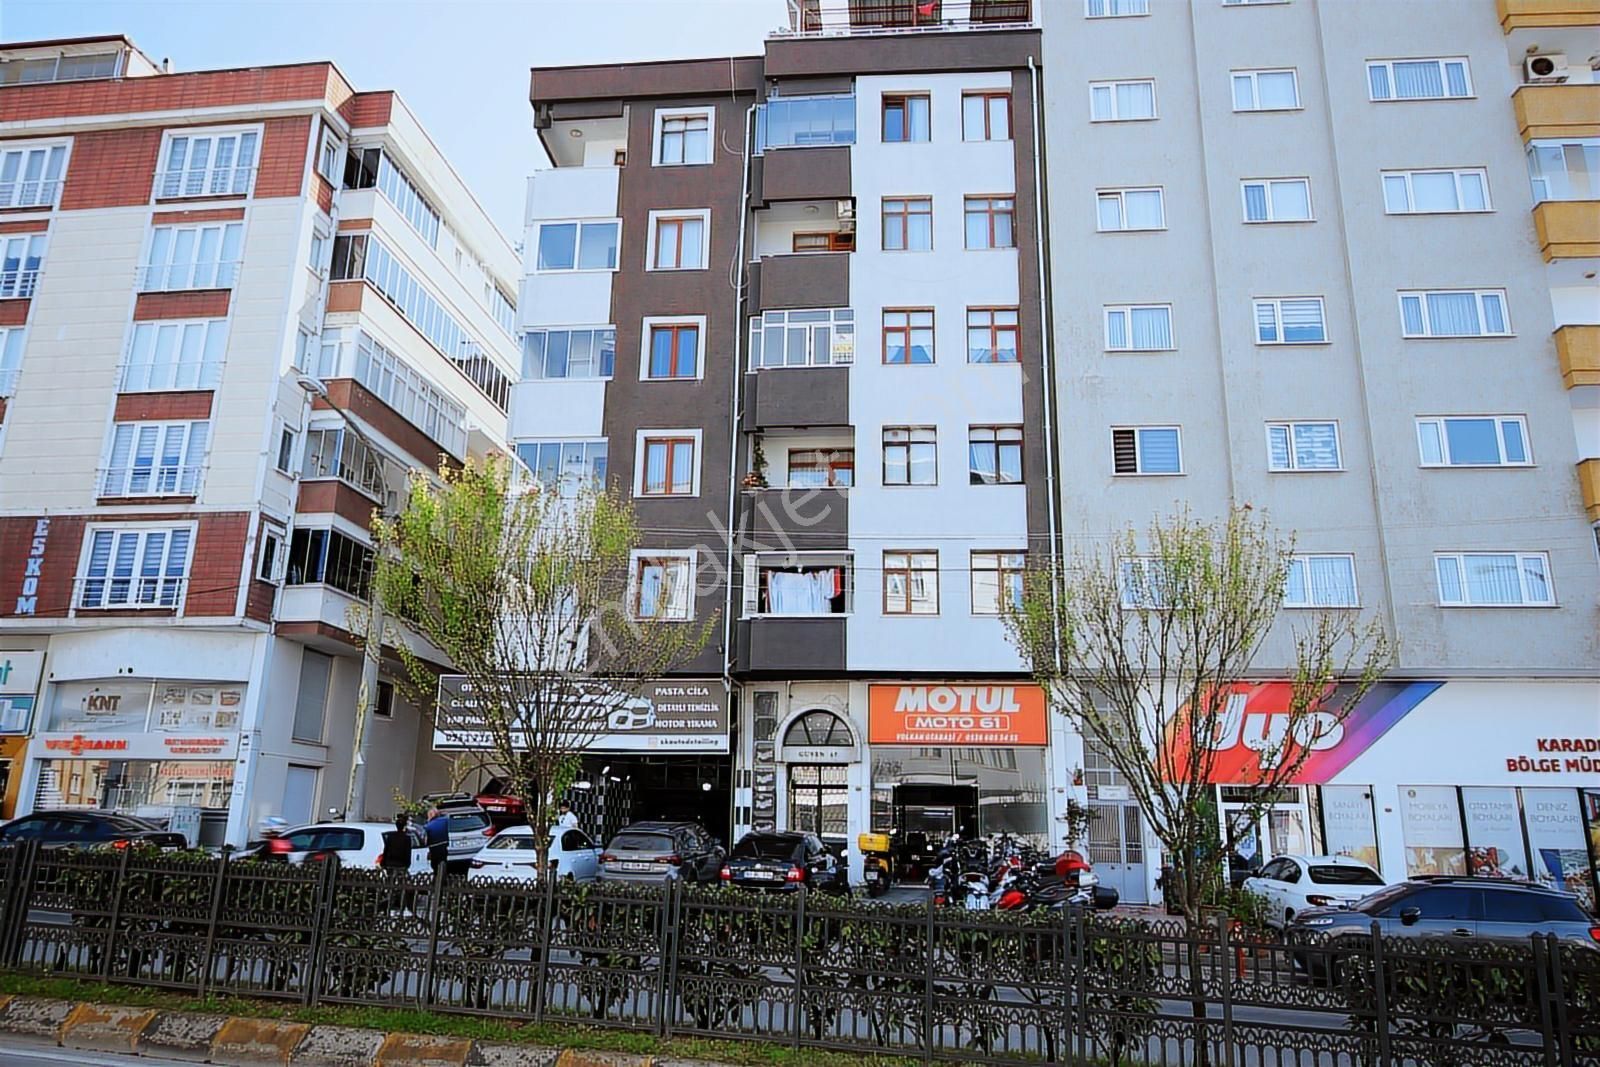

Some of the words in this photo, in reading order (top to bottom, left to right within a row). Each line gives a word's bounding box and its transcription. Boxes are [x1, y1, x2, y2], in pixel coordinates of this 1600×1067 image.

[14, 519, 51, 615] ESKOM
[655, 687, 685, 696] PASTA
[687, 686, 709, 696] CİLA
[86, 695, 121, 712] KNT
[894, 687, 1020, 713] MOTUL
[655, 719, 685, 728] MOTOR
[915, 717, 974, 729] MOTO
[979, 717, 1000, 729] 61
[1537, 738, 1600, 752] KARAD
[1506, 755, 1562, 772] BÖLGE
